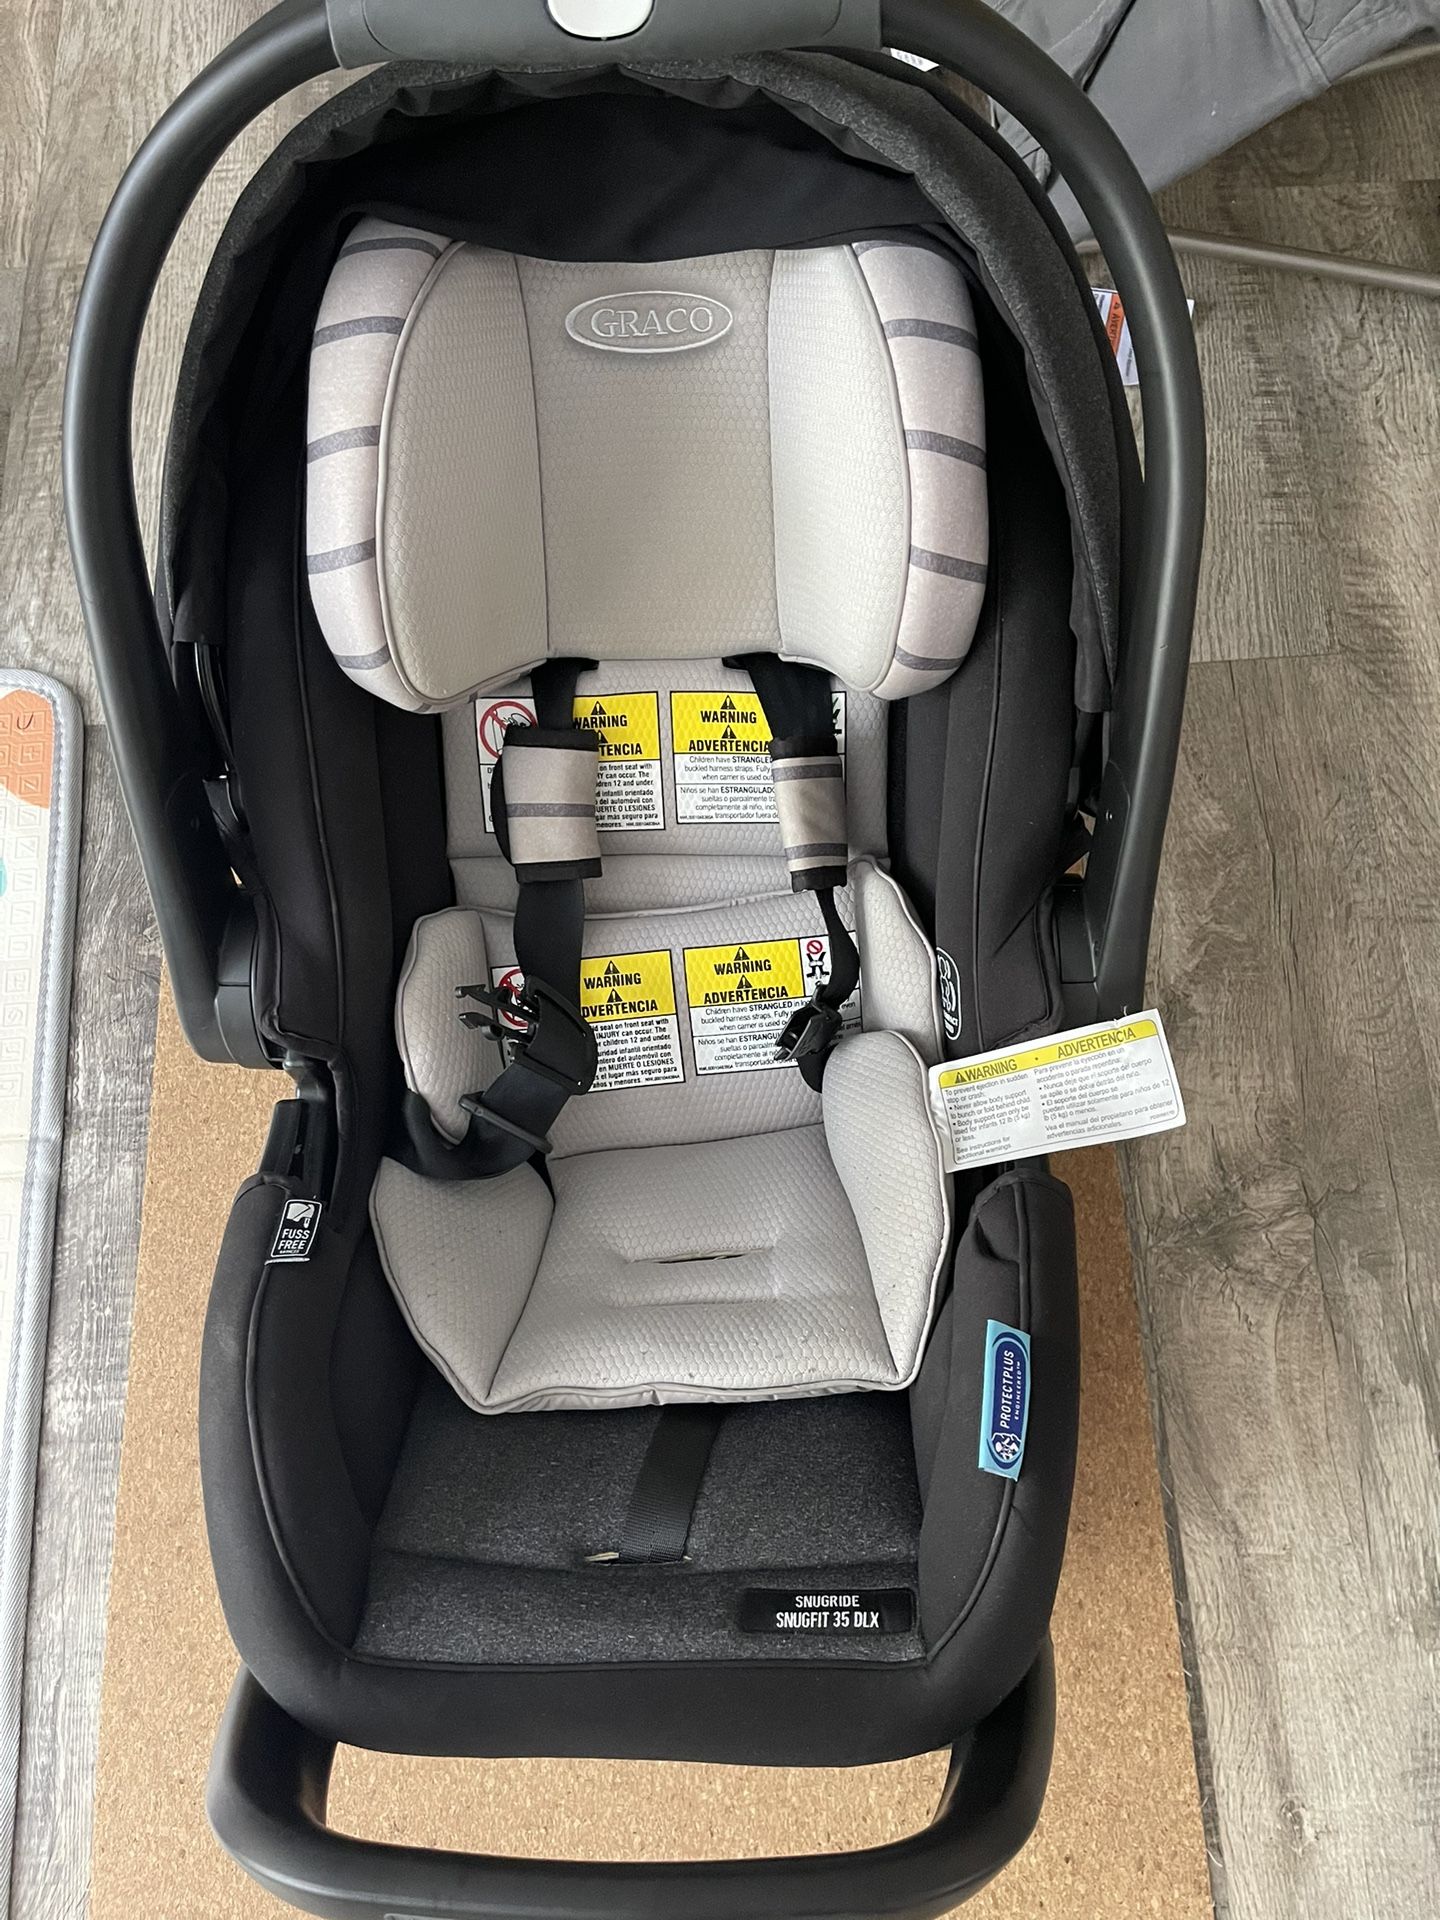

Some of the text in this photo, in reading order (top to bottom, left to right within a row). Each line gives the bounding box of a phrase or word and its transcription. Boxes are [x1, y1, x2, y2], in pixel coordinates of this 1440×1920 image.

[590, 306, 713, 338] GRACO
[700, 710, 757, 724] WARNING
[600, 742, 643, 756] TENCIA
[688, 740, 769, 752] ADVERTENCIA
[756, 766, 770, 774] Fully
[714, 959, 772, 975] WARNING
[584, 972, 642, 989] WARNING
[704, 986, 788, 1004] ADVERTENCIA
[581, 1000, 658, 1017] DVERTENCIA
[706, 1007, 731, 1016] Children
[749, 1001, 792, 1012] STRANGLED
[842, 1001, 855, 1009] even
[726, 1014, 750, 1022] harness
[774, 1010, 788, 1018] Fully
[596, 1031, 620, 1040] INJURY
[603, 1038, 628, 1046] children
[628, 1052, 658, 1061] automóvil
[714, 1052, 761, 1061] completamente
[965, 1027, 1136, 1081] WARNING ADVERTENCIA
[609, 1062, 635, 1071] MUERTE
[643, 1058, 674, 1067] LESIONES
[735, 1059, 776, 1067] transportador
[608, 1071, 624, 1080] lugar
[640, 1067, 661, 1076] seguro
[663, 1066, 677, 1074] para
[1034, 1066, 1048, 1075] Para
[1044, 1080, 1062, 1090] Nunca
[1131, 1058, 1152, 1069] cuerpo
[593, 1080, 608, 1088] años
[954, 1086, 975, 1095] prevent
[977, 1080, 998, 1090] ejection
[1007, 1073, 1027, 1082] sudden
[948, 1097, 959, 1105] stop
[954, 1102, 971, 1111] Never
[989, 1095, 1002, 1104] body
[1005, 1090, 1026, 1100] support
[1043, 1104, 1064, 1114] pueden
[1120, 1090, 1133, 1099] para
[1162, 1079, 1169, 1087] 12
[1055, 1095, 1076, 1105] soporte
[1089, 1088, 1109, 1098] cuerpo
[958, 1109, 975, 1118] bunch
[996, 1100, 1015, 1110] behind
[1135, 1106, 1148, 1114] para
[958, 1118, 972, 1128] Body
[974, 1113, 995, 1124] support
[1008, 1107, 1020, 1117] only
[957, 1145, 968, 1154] See
[970, 1138, 1001, 1150] instructions
[282, 1228, 310, 1240] FUSS
[278, 1240, 307, 1250] FREE
[1000, 1350, 1014, 1428] PROTECTPLUS
[795, 1595, 860, 1608] SNUGRIDE
[776, 1611, 879, 1628] SNUGFIT 35 DLX
